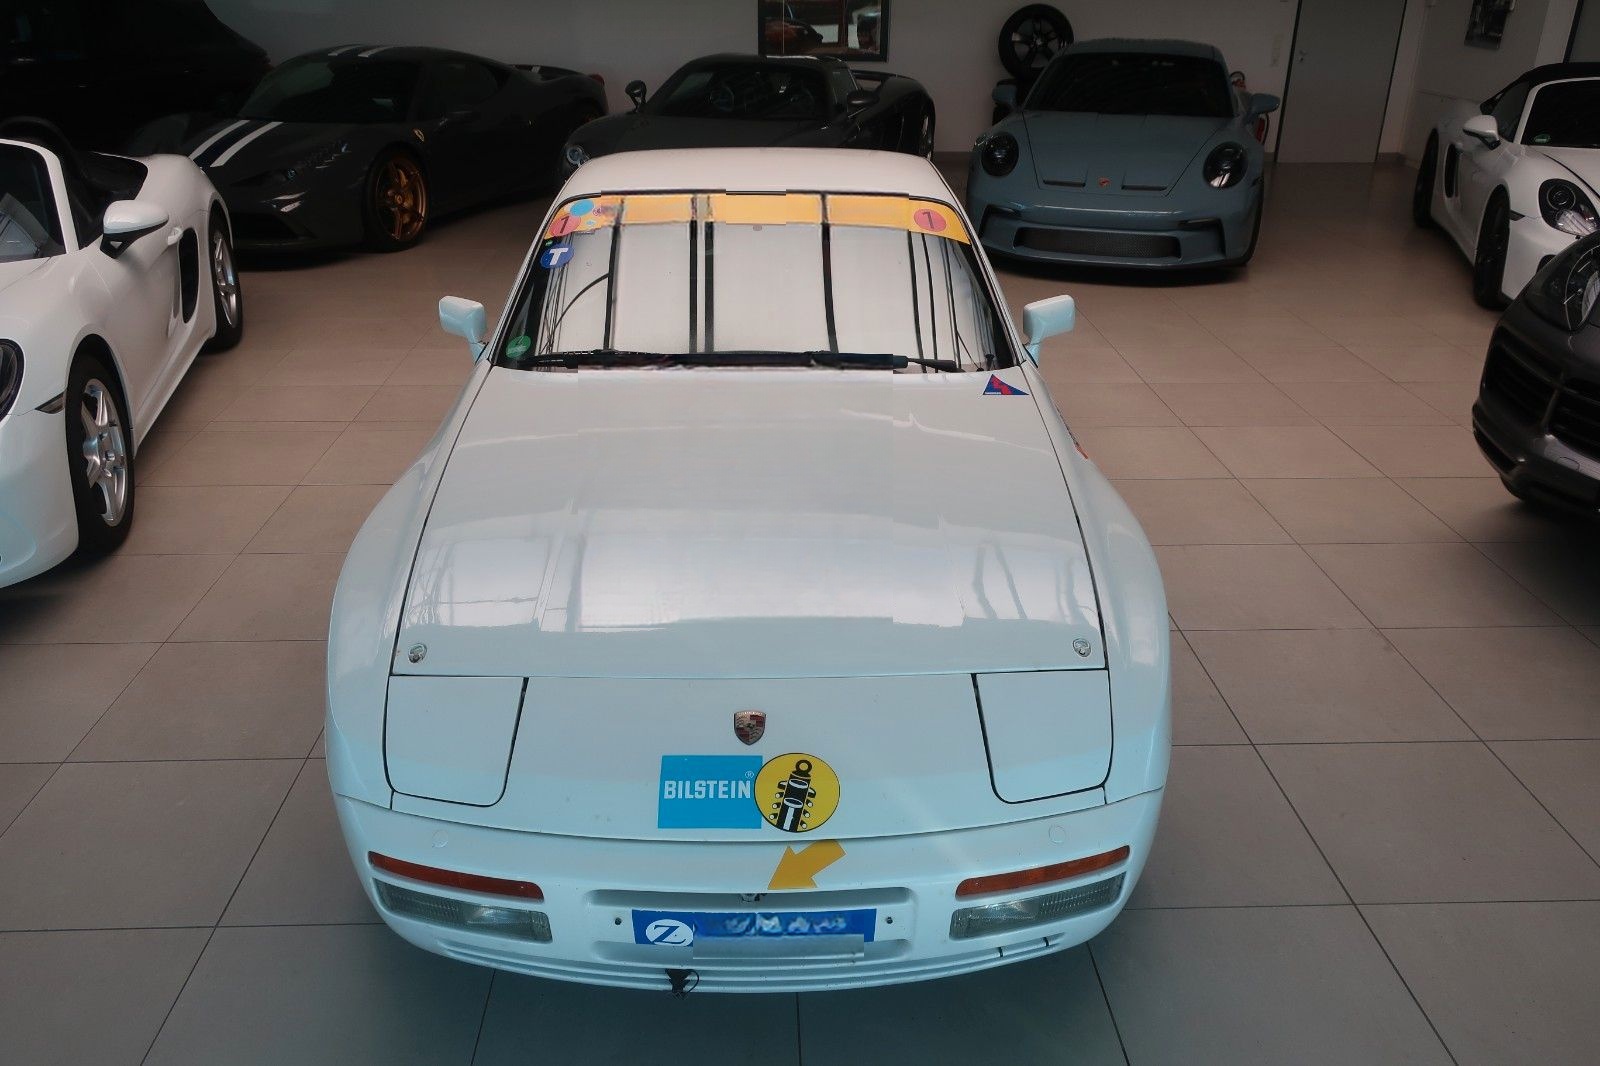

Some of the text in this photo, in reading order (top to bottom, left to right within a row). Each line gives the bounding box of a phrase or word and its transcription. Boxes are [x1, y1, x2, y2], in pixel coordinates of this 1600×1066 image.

[560, 215, 570, 234] 1
[922, 211, 934, 229] 1
[549, 247, 569, 266] T
[663, 780, 751, 799] BILSTEIN
[653, 924, 687, 944] Z
